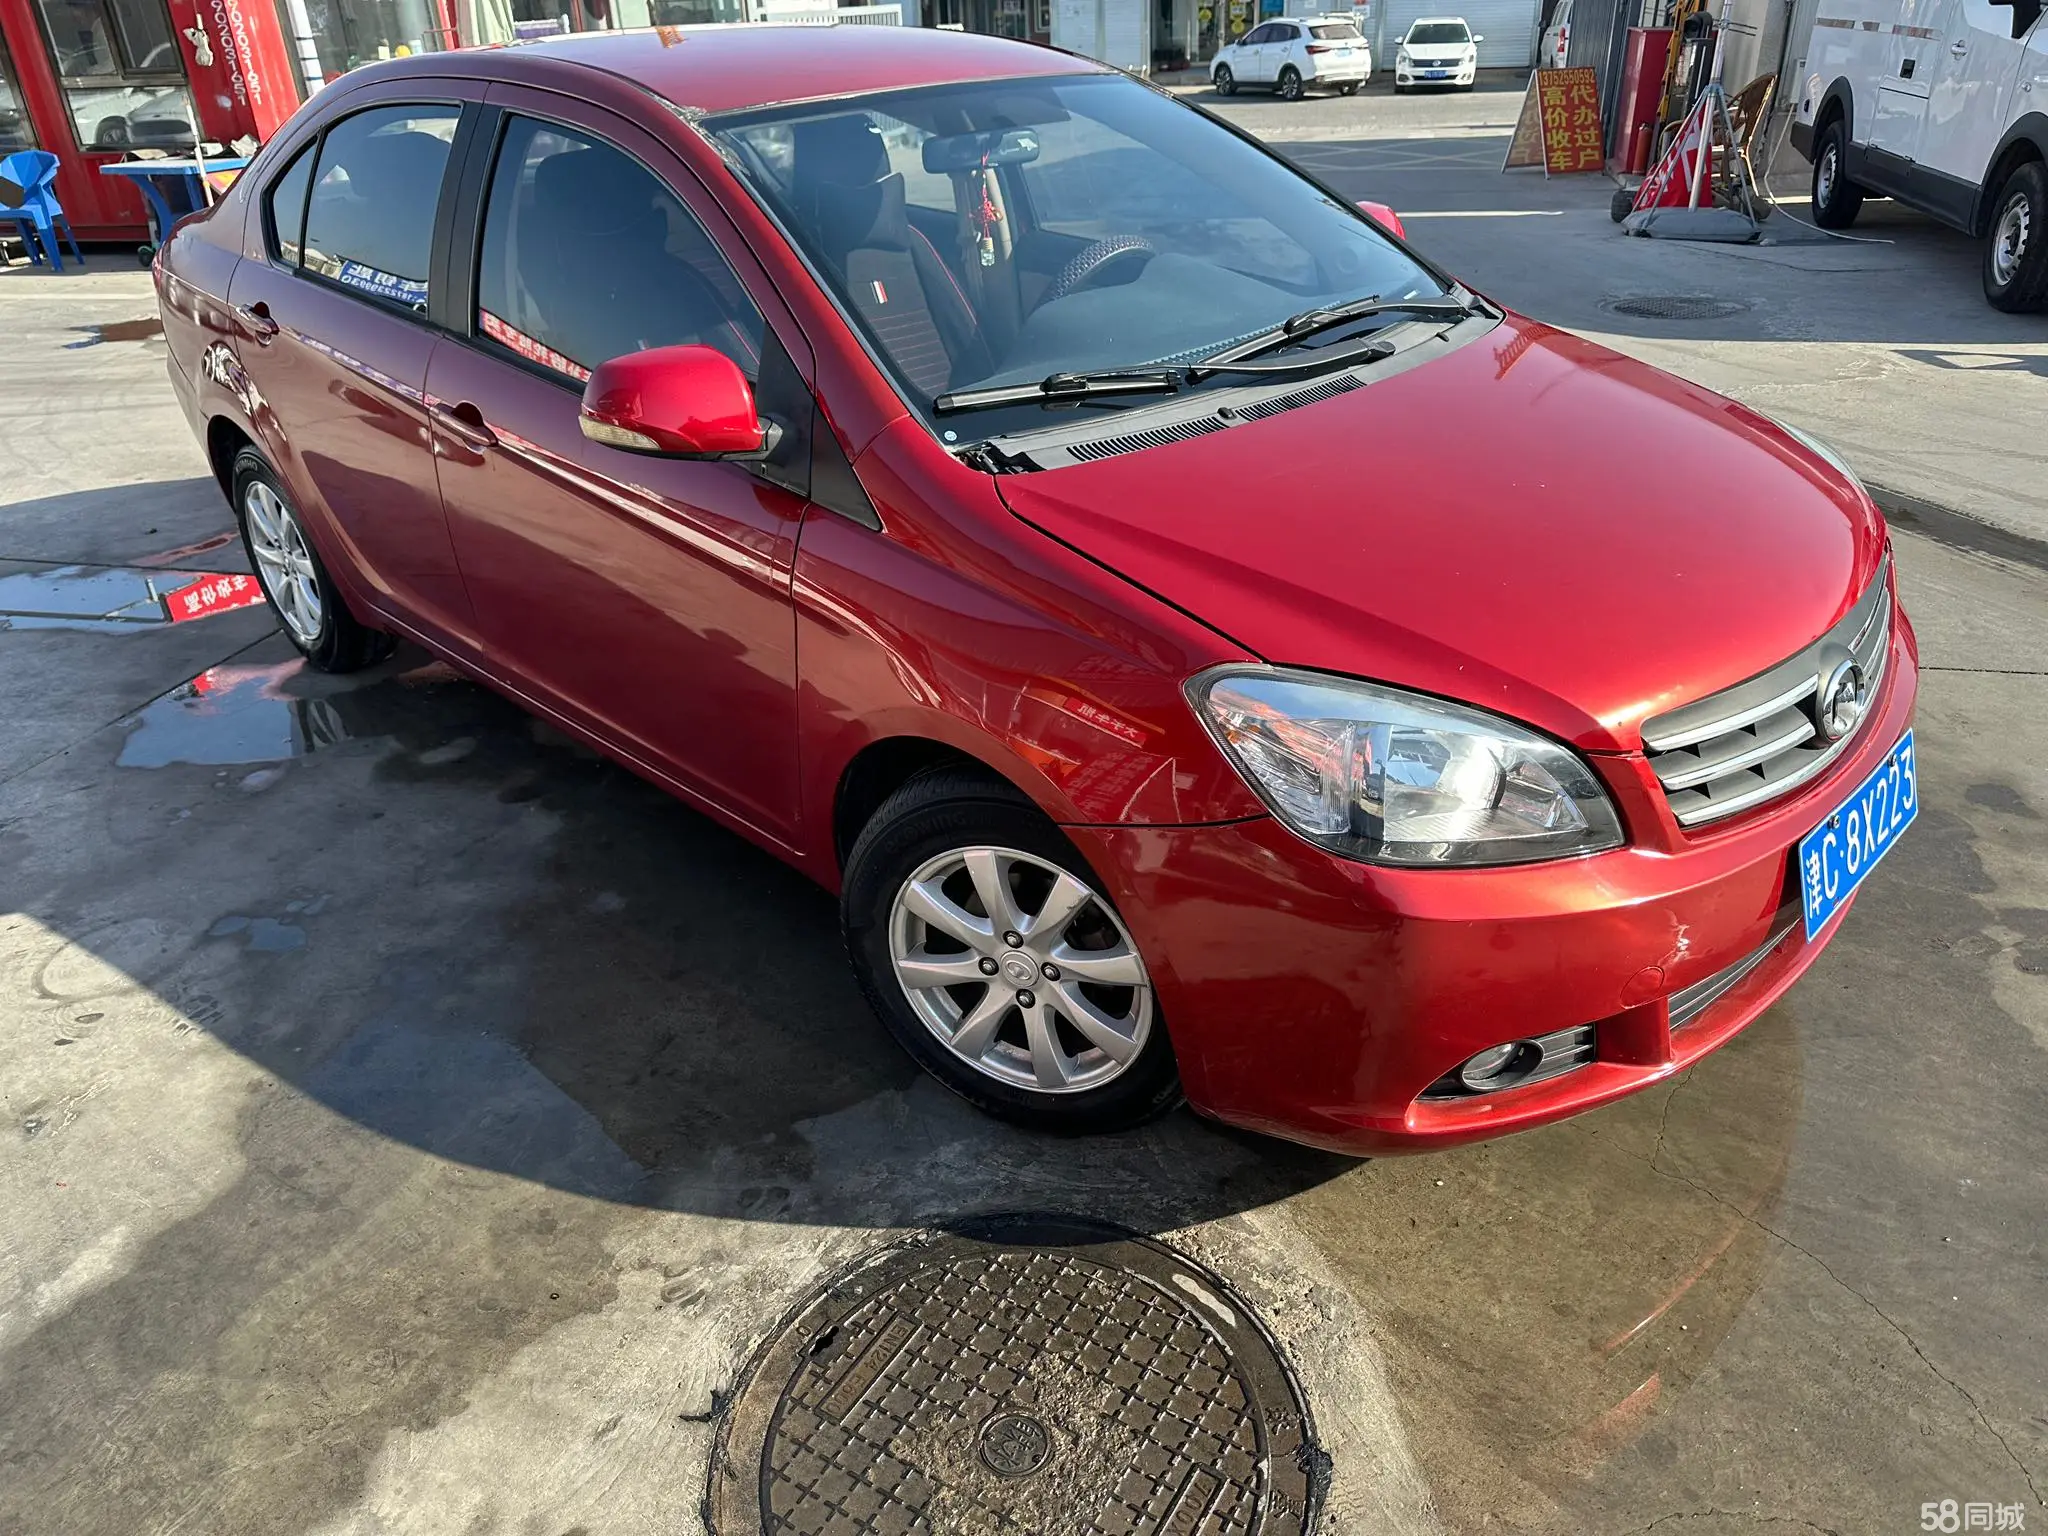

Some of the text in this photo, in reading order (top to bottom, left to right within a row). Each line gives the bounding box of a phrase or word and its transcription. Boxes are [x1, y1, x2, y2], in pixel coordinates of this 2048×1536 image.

[1538, 69, 1596, 86] 13752550592
[1542, 86, 1574, 170] 高价收车
[1571, 84, 1601, 169] 代办过户
